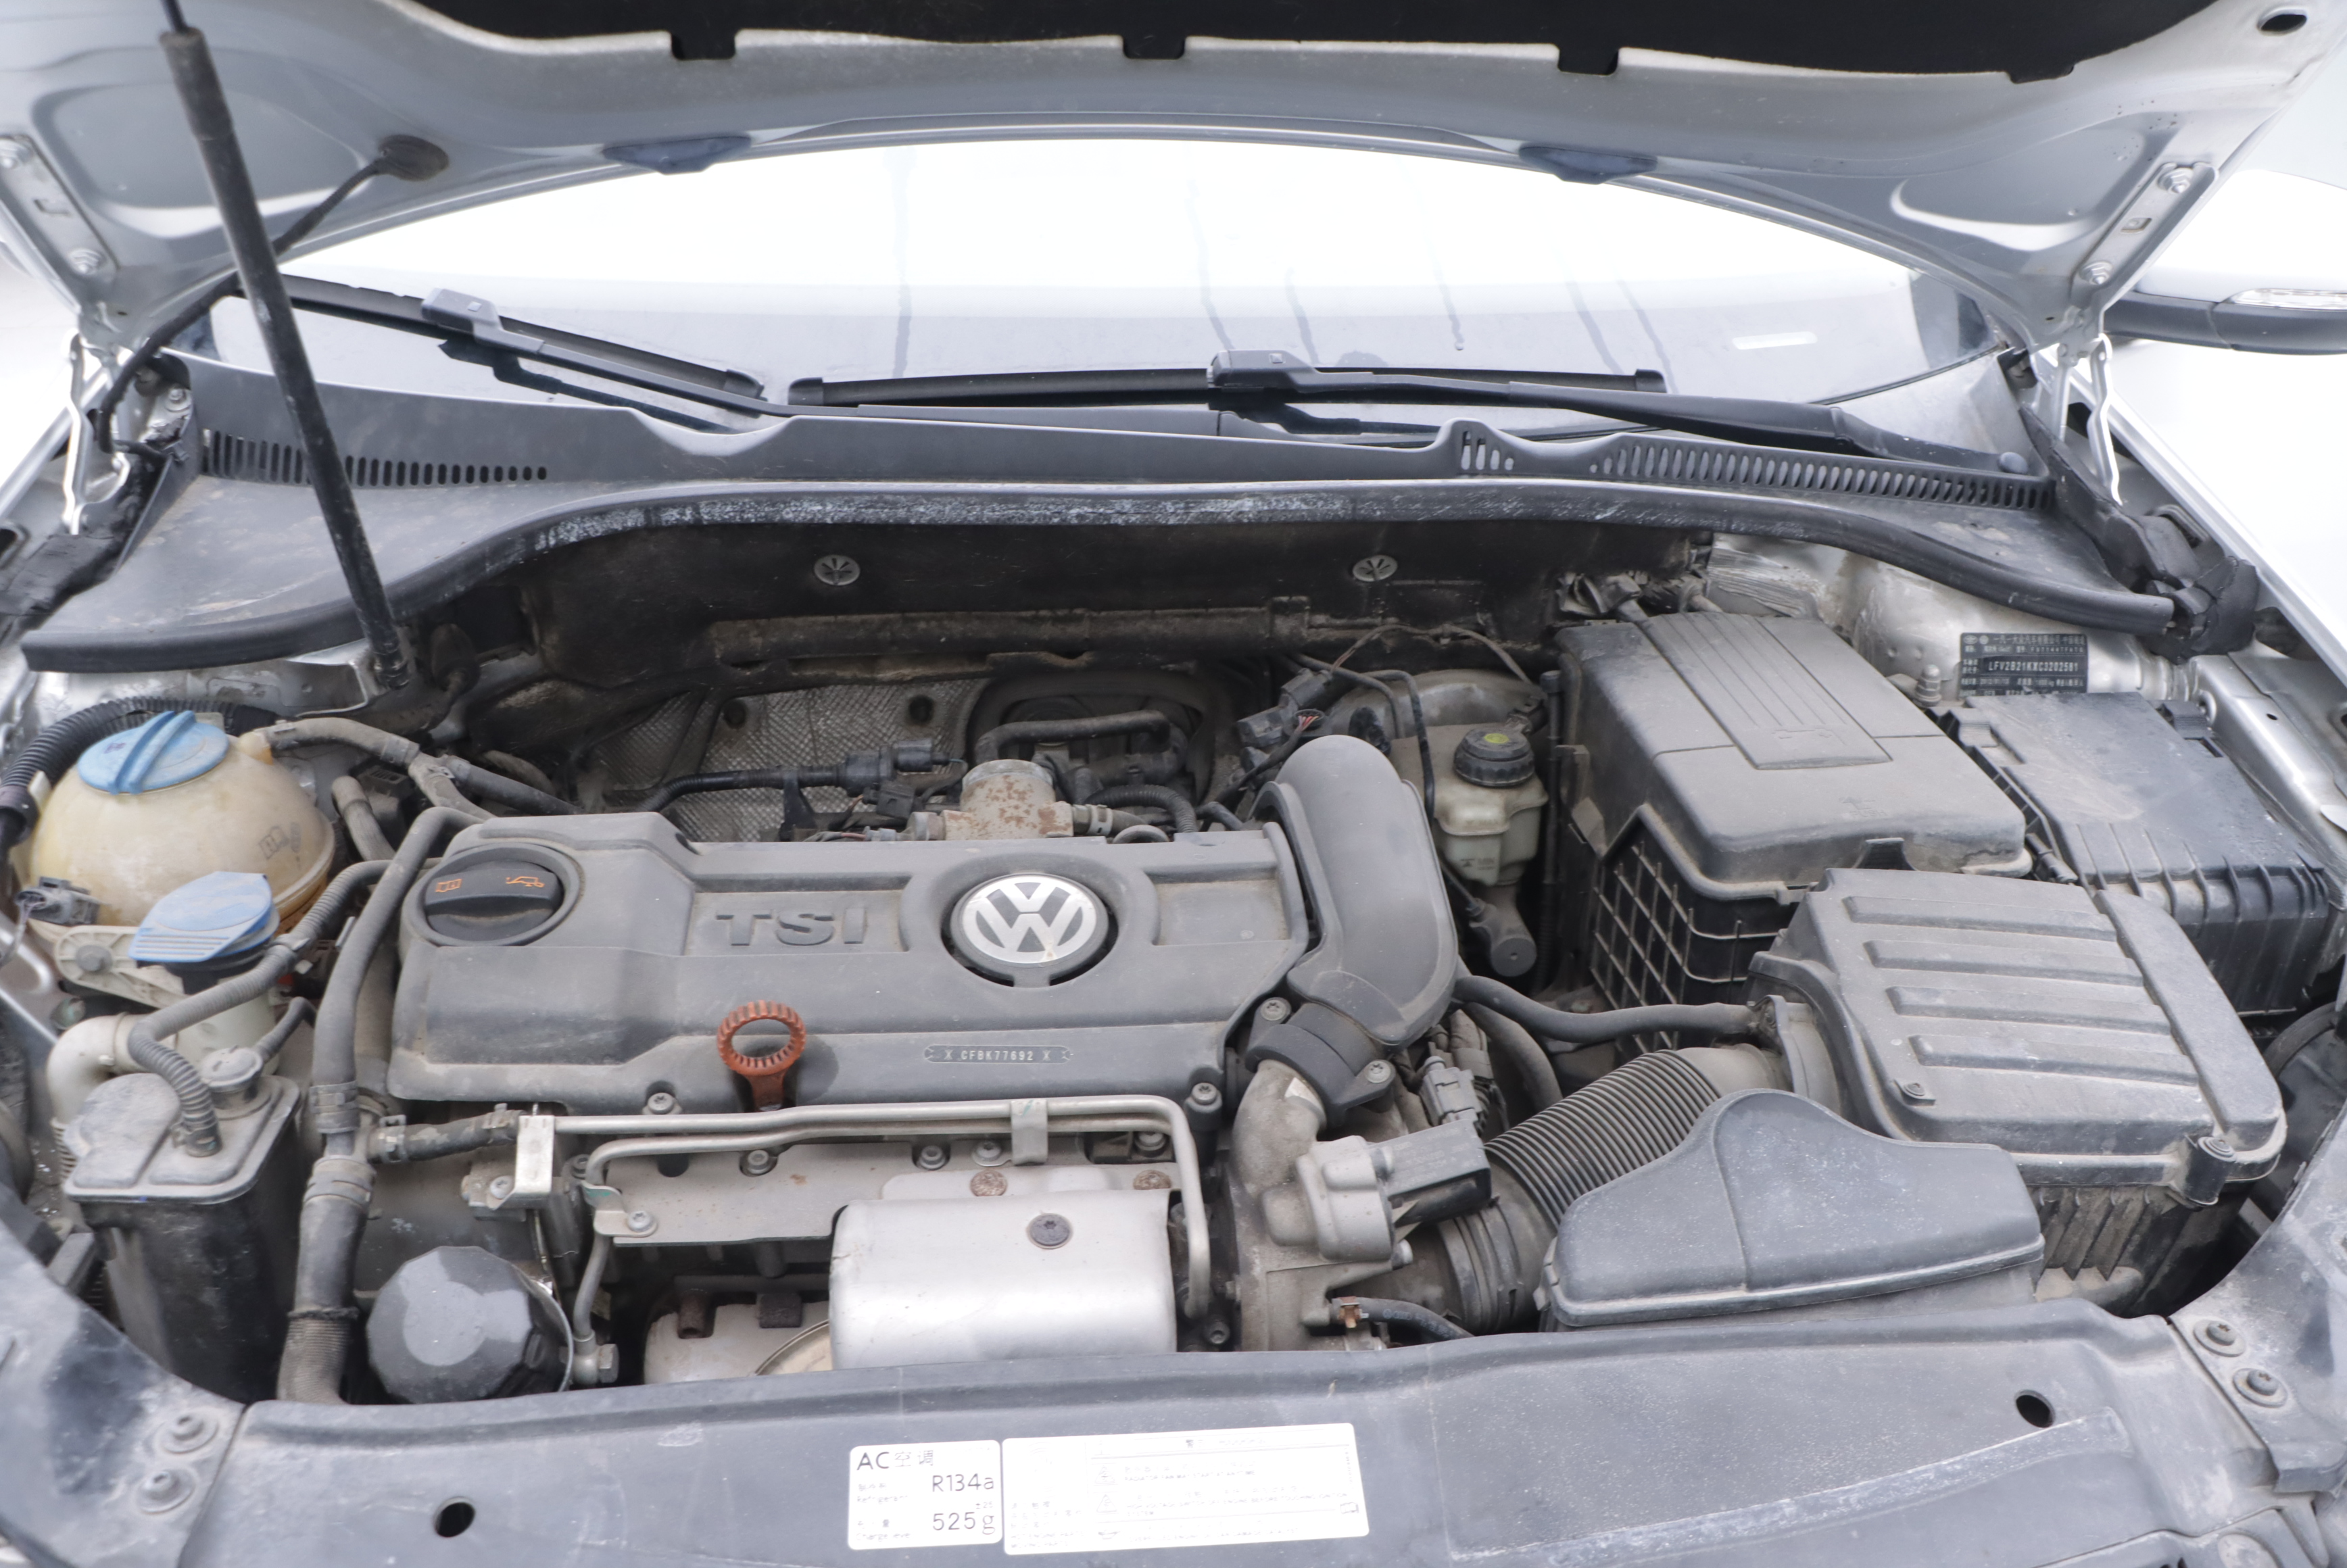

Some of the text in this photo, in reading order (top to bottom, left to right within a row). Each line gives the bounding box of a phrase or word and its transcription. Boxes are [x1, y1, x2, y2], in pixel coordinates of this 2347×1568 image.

[1988, 661, 2079, 671] LFV2B21KXC3202581
[715, 907, 867, 946] TSI
[961, 1050, 1034, 1061] CFBK77692
[932, 1473, 995, 1493] R134a
